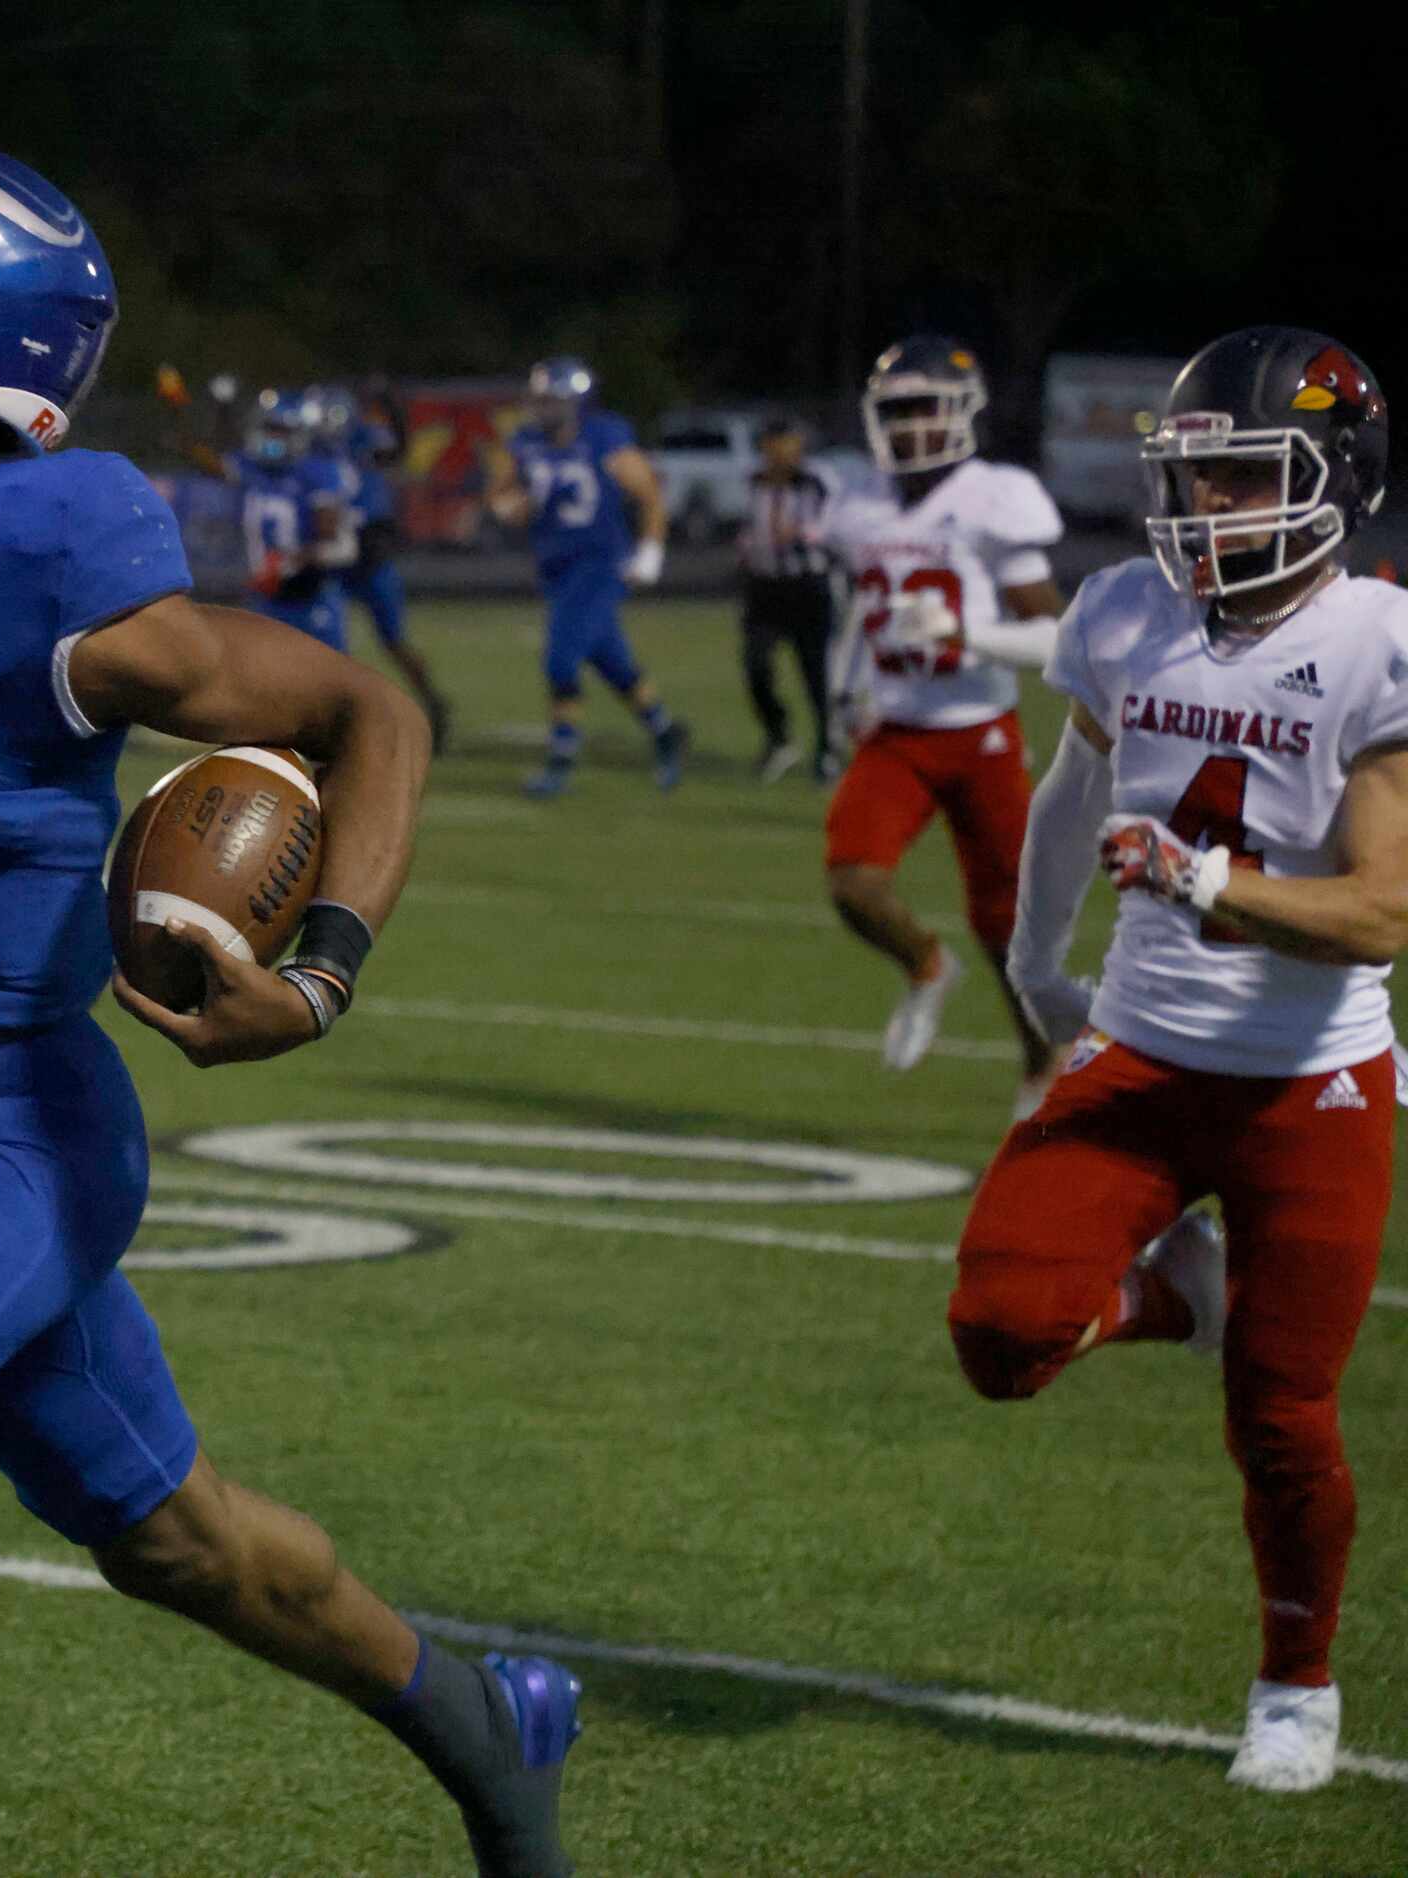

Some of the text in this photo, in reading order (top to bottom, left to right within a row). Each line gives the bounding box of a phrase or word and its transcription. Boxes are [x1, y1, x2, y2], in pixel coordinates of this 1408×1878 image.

[1274, 677, 1325, 699] adidas
[1121, 694, 1314, 757] CARDINALS
[1166, 755, 1265, 944] 4
